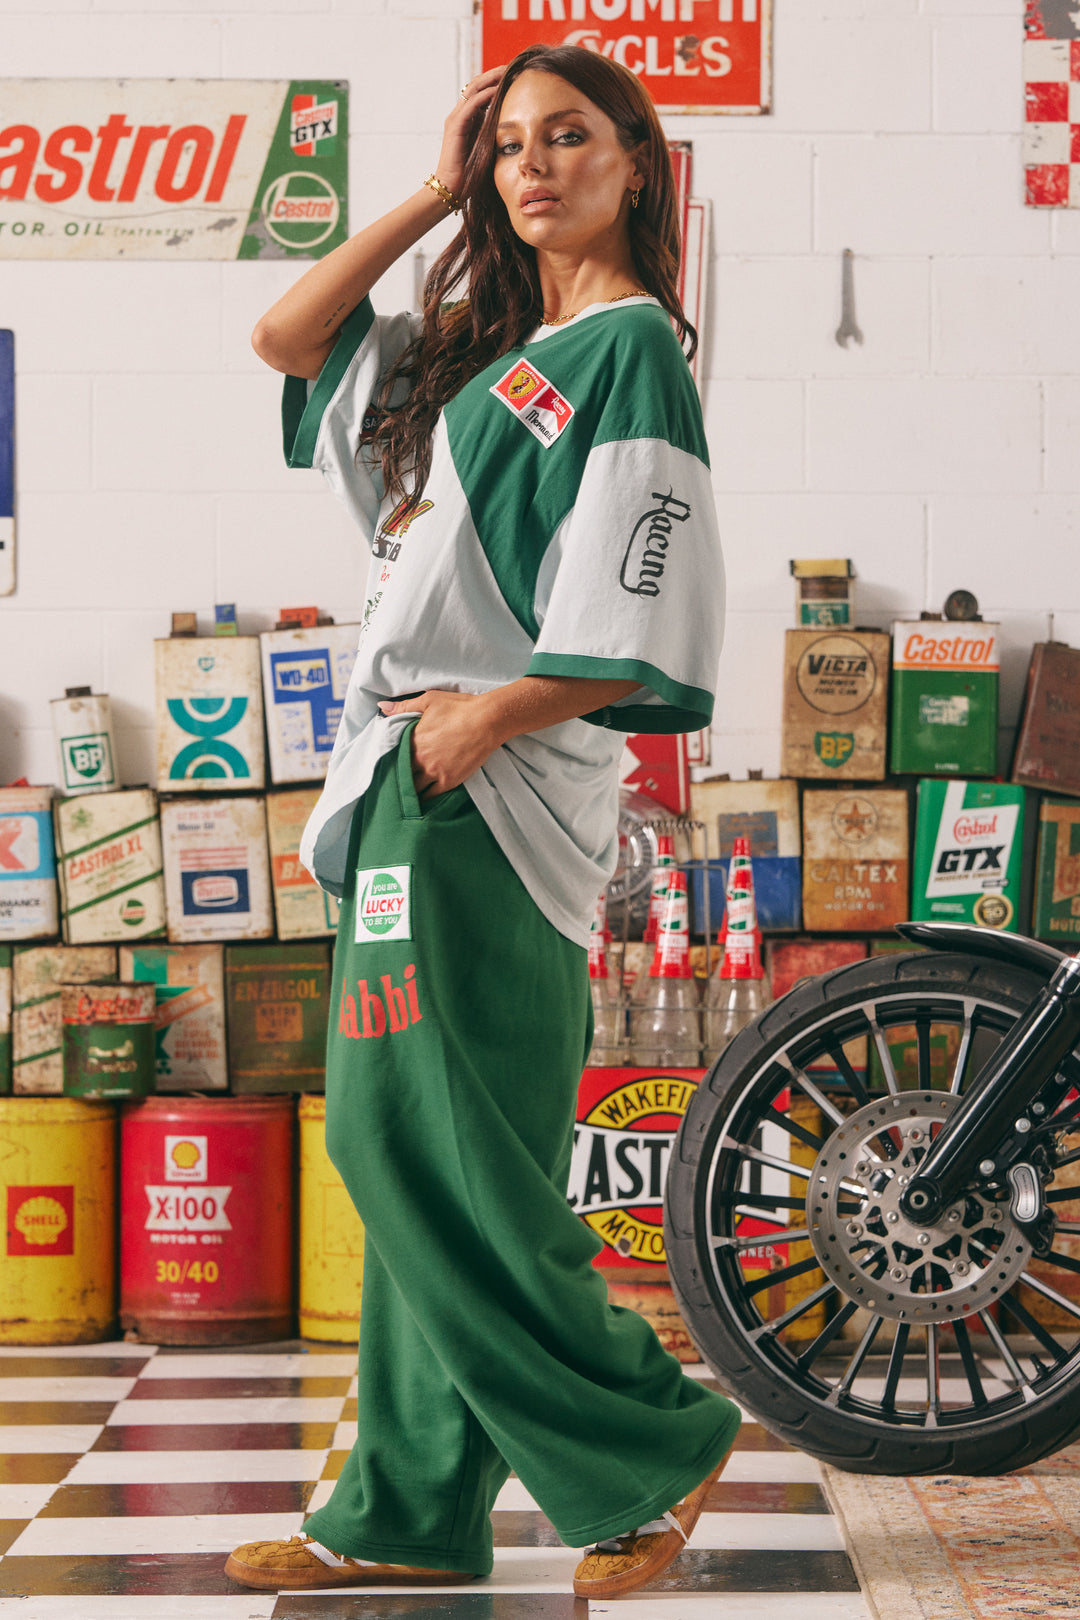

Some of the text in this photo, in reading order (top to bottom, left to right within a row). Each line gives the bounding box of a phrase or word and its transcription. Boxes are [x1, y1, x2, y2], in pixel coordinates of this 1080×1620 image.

[295, 119, 332, 143] GTX
[274, 199, 334, 218] Castrol
[64, 222, 105, 237] OIL
[903, 633, 994, 663] Castrol
[74, 746, 104, 771] BP
[820, 736, 853, 760] BP
[953, 814, 999, 844] Castrol
[69, 842, 125, 880] CASTROL
[126, 834, 143, 855] XL
[937, 844, 1006, 874] GTX
[811, 864, 898, 884] CALTEX
[373, 882, 398, 895] you are
[834, 885, 872, 899] RPM
[366, 897, 405, 914] LUCKY
[364, 916, 398, 928] TO BE YOU
[235, 978, 321, 1001] ENERGOL
[601, 1083, 692, 1124] WAKEFI
[156, 1196, 218, 1220] X-100
[23, 1215, 61, 1226] SHELL
[150, 1234, 223, 1245] MOTOR OIL
[156, 1260, 219, 1284] 30/40
